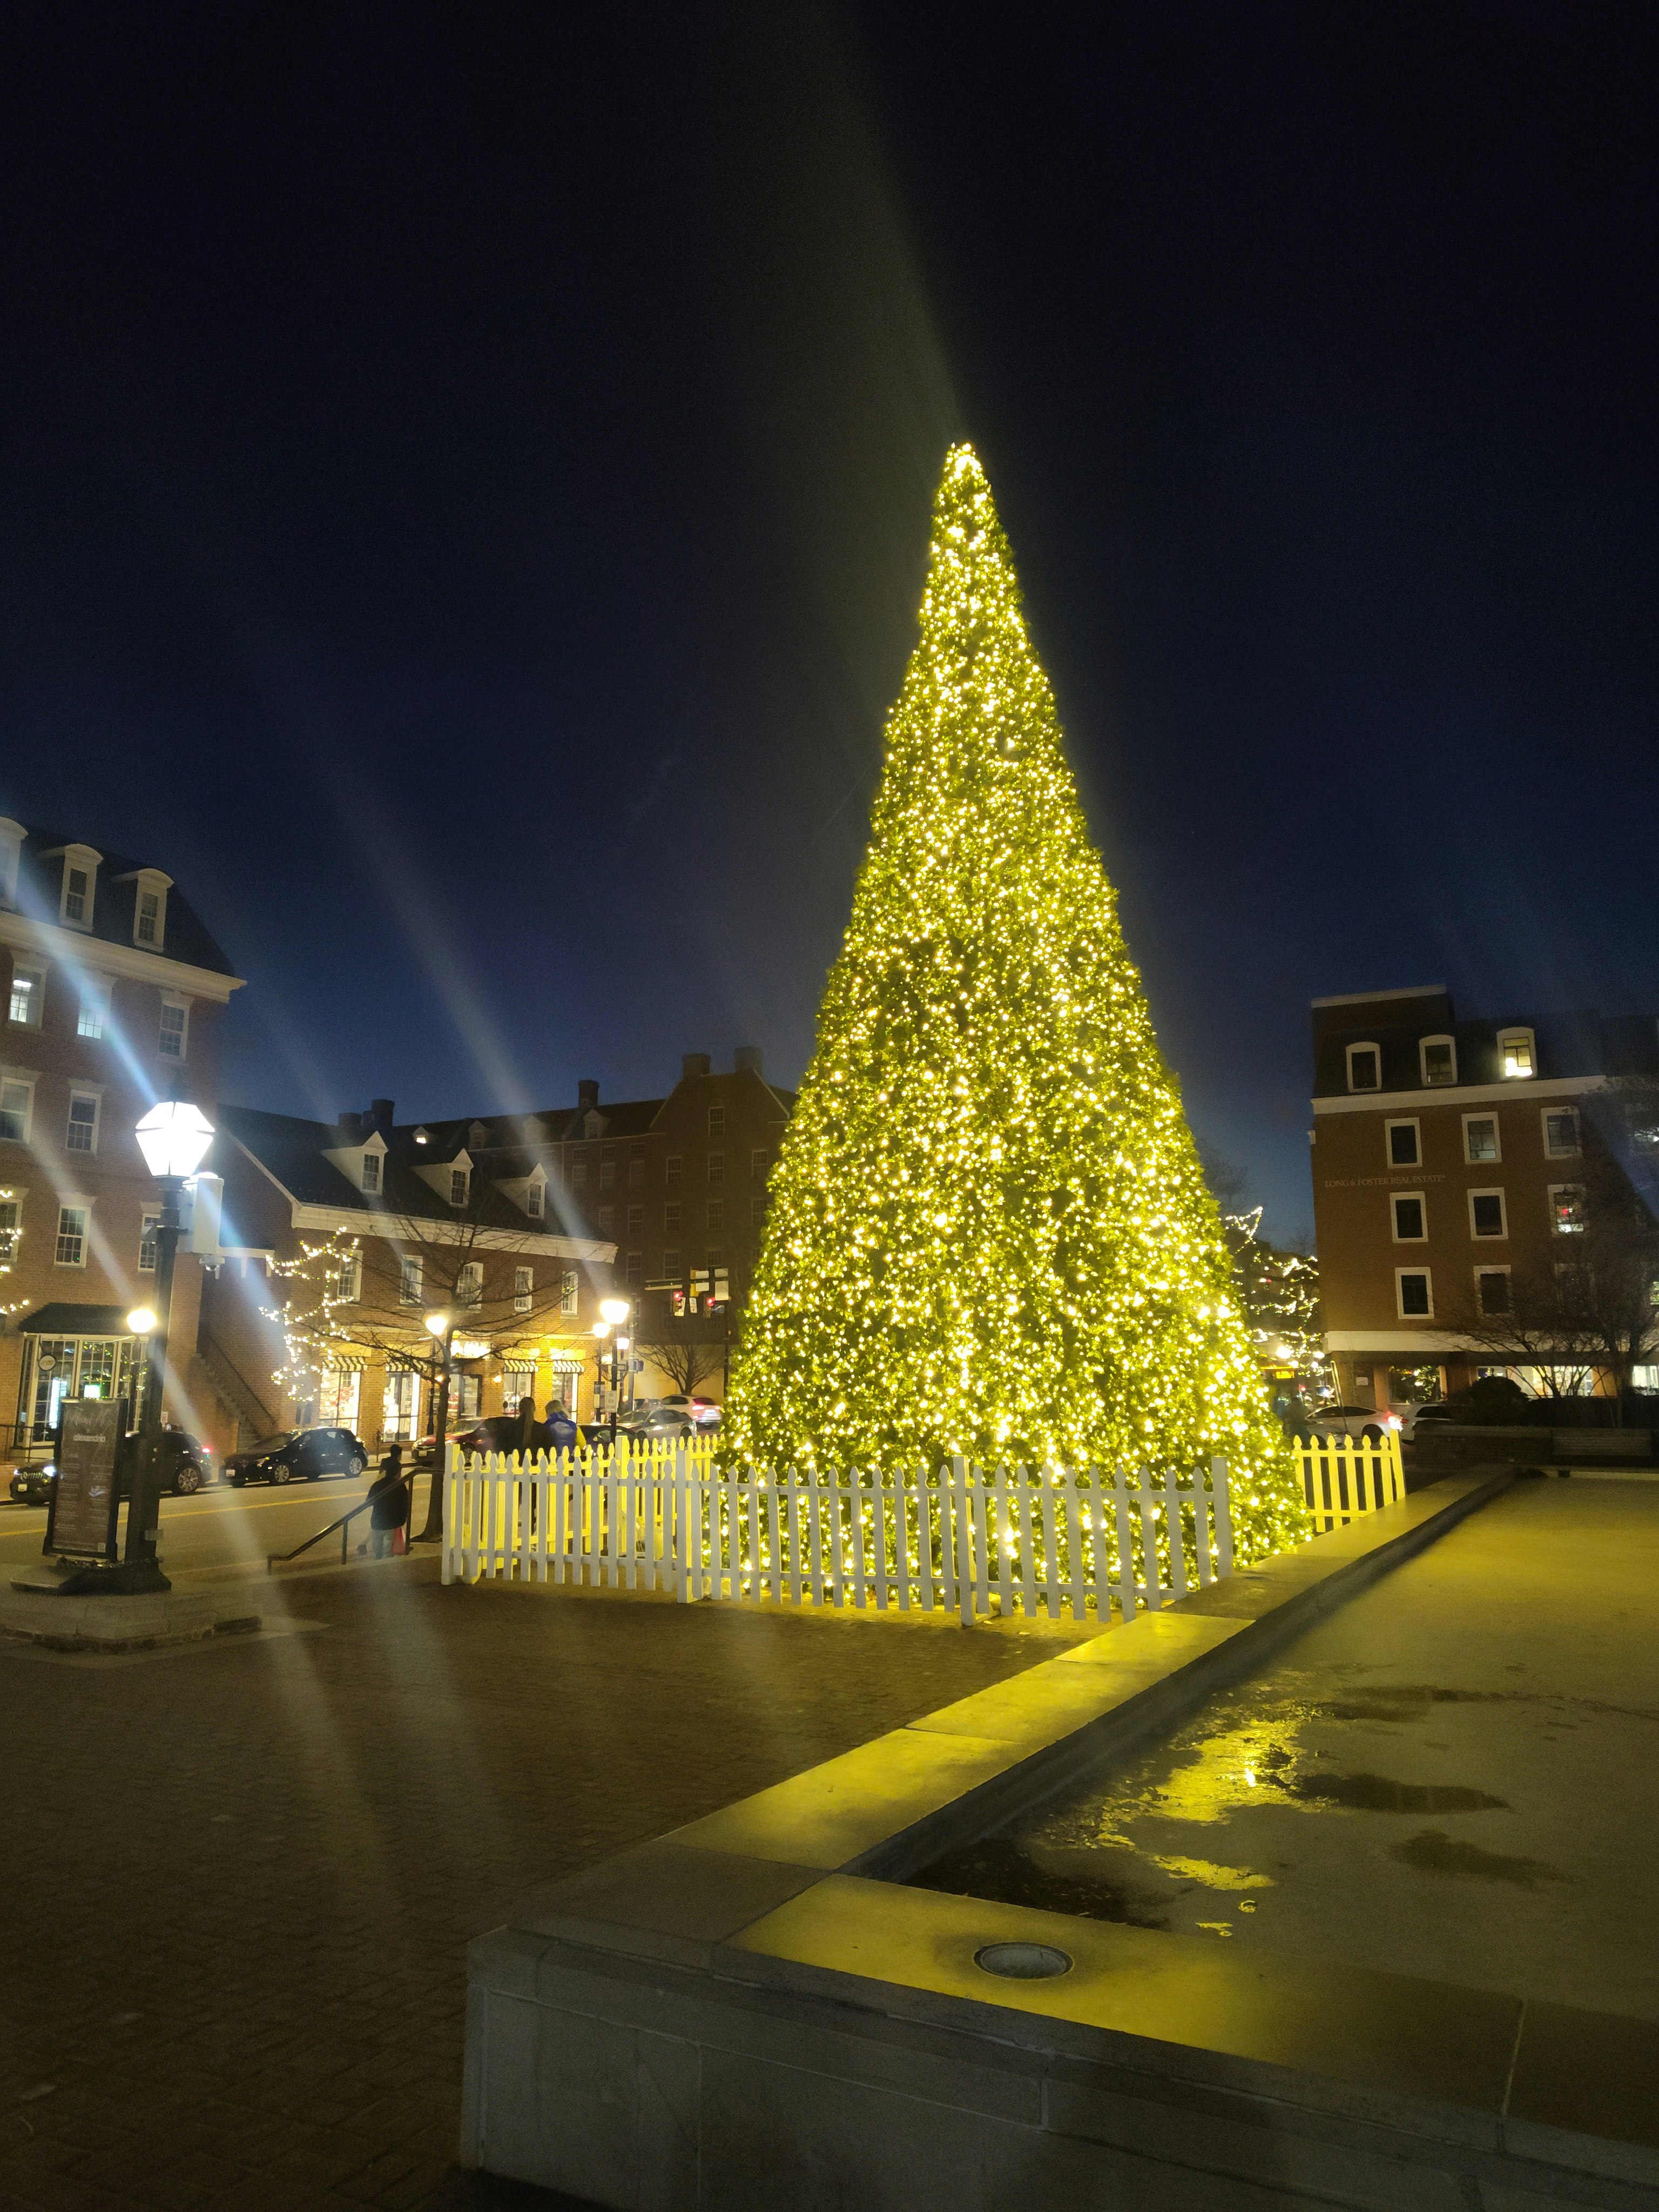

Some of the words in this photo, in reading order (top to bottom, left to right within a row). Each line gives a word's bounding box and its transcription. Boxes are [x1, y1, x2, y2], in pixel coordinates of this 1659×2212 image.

[1325, 1179, 1349, 1188] LONG
[1358, 1177, 1388, 1186] FOSTER
[1391, 1176, 1411, 1184] REAL
